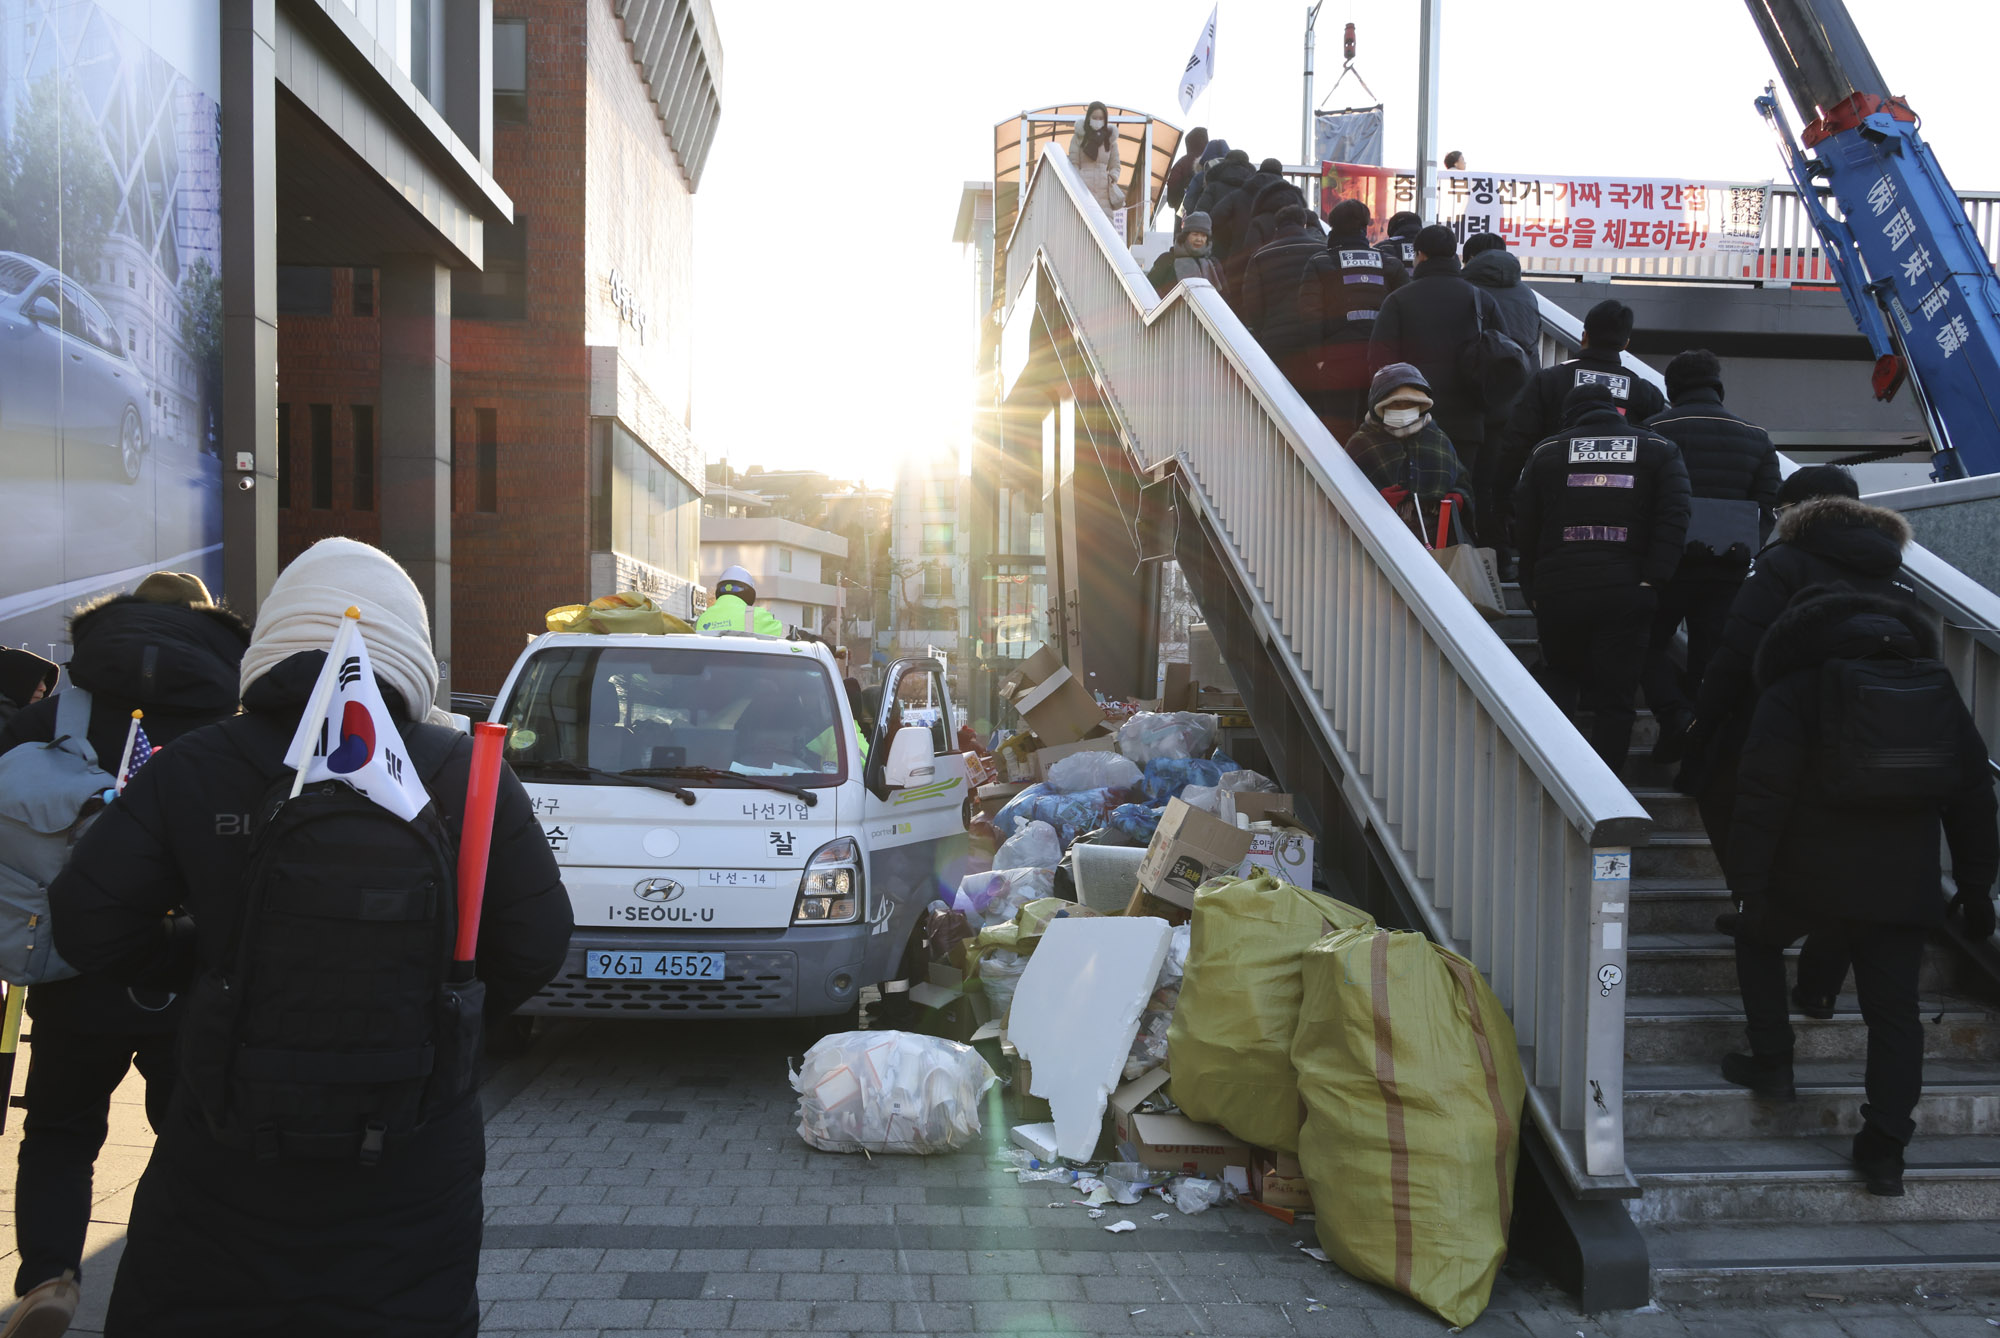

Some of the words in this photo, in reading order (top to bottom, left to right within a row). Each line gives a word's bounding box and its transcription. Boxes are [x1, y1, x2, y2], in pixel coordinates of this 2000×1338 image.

[1608, 183, 1654, 210] 국개
[1661, 184, 1706, 211] 간첩
[1436, 214, 1490, 245] 세력
[1500, 216, 1597, 248] 민주당을
[1602, 219, 1708, 250] 체포하라!
[1578, 451, 1627, 460] POLICE
[531, 796, 560, 815] 산구
[742, 803, 809, 821] 나선기업
[769, 831, 797, 856] 찰
[599, 954, 643, 975] 96고
[654, 955, 713, 977] 4552
